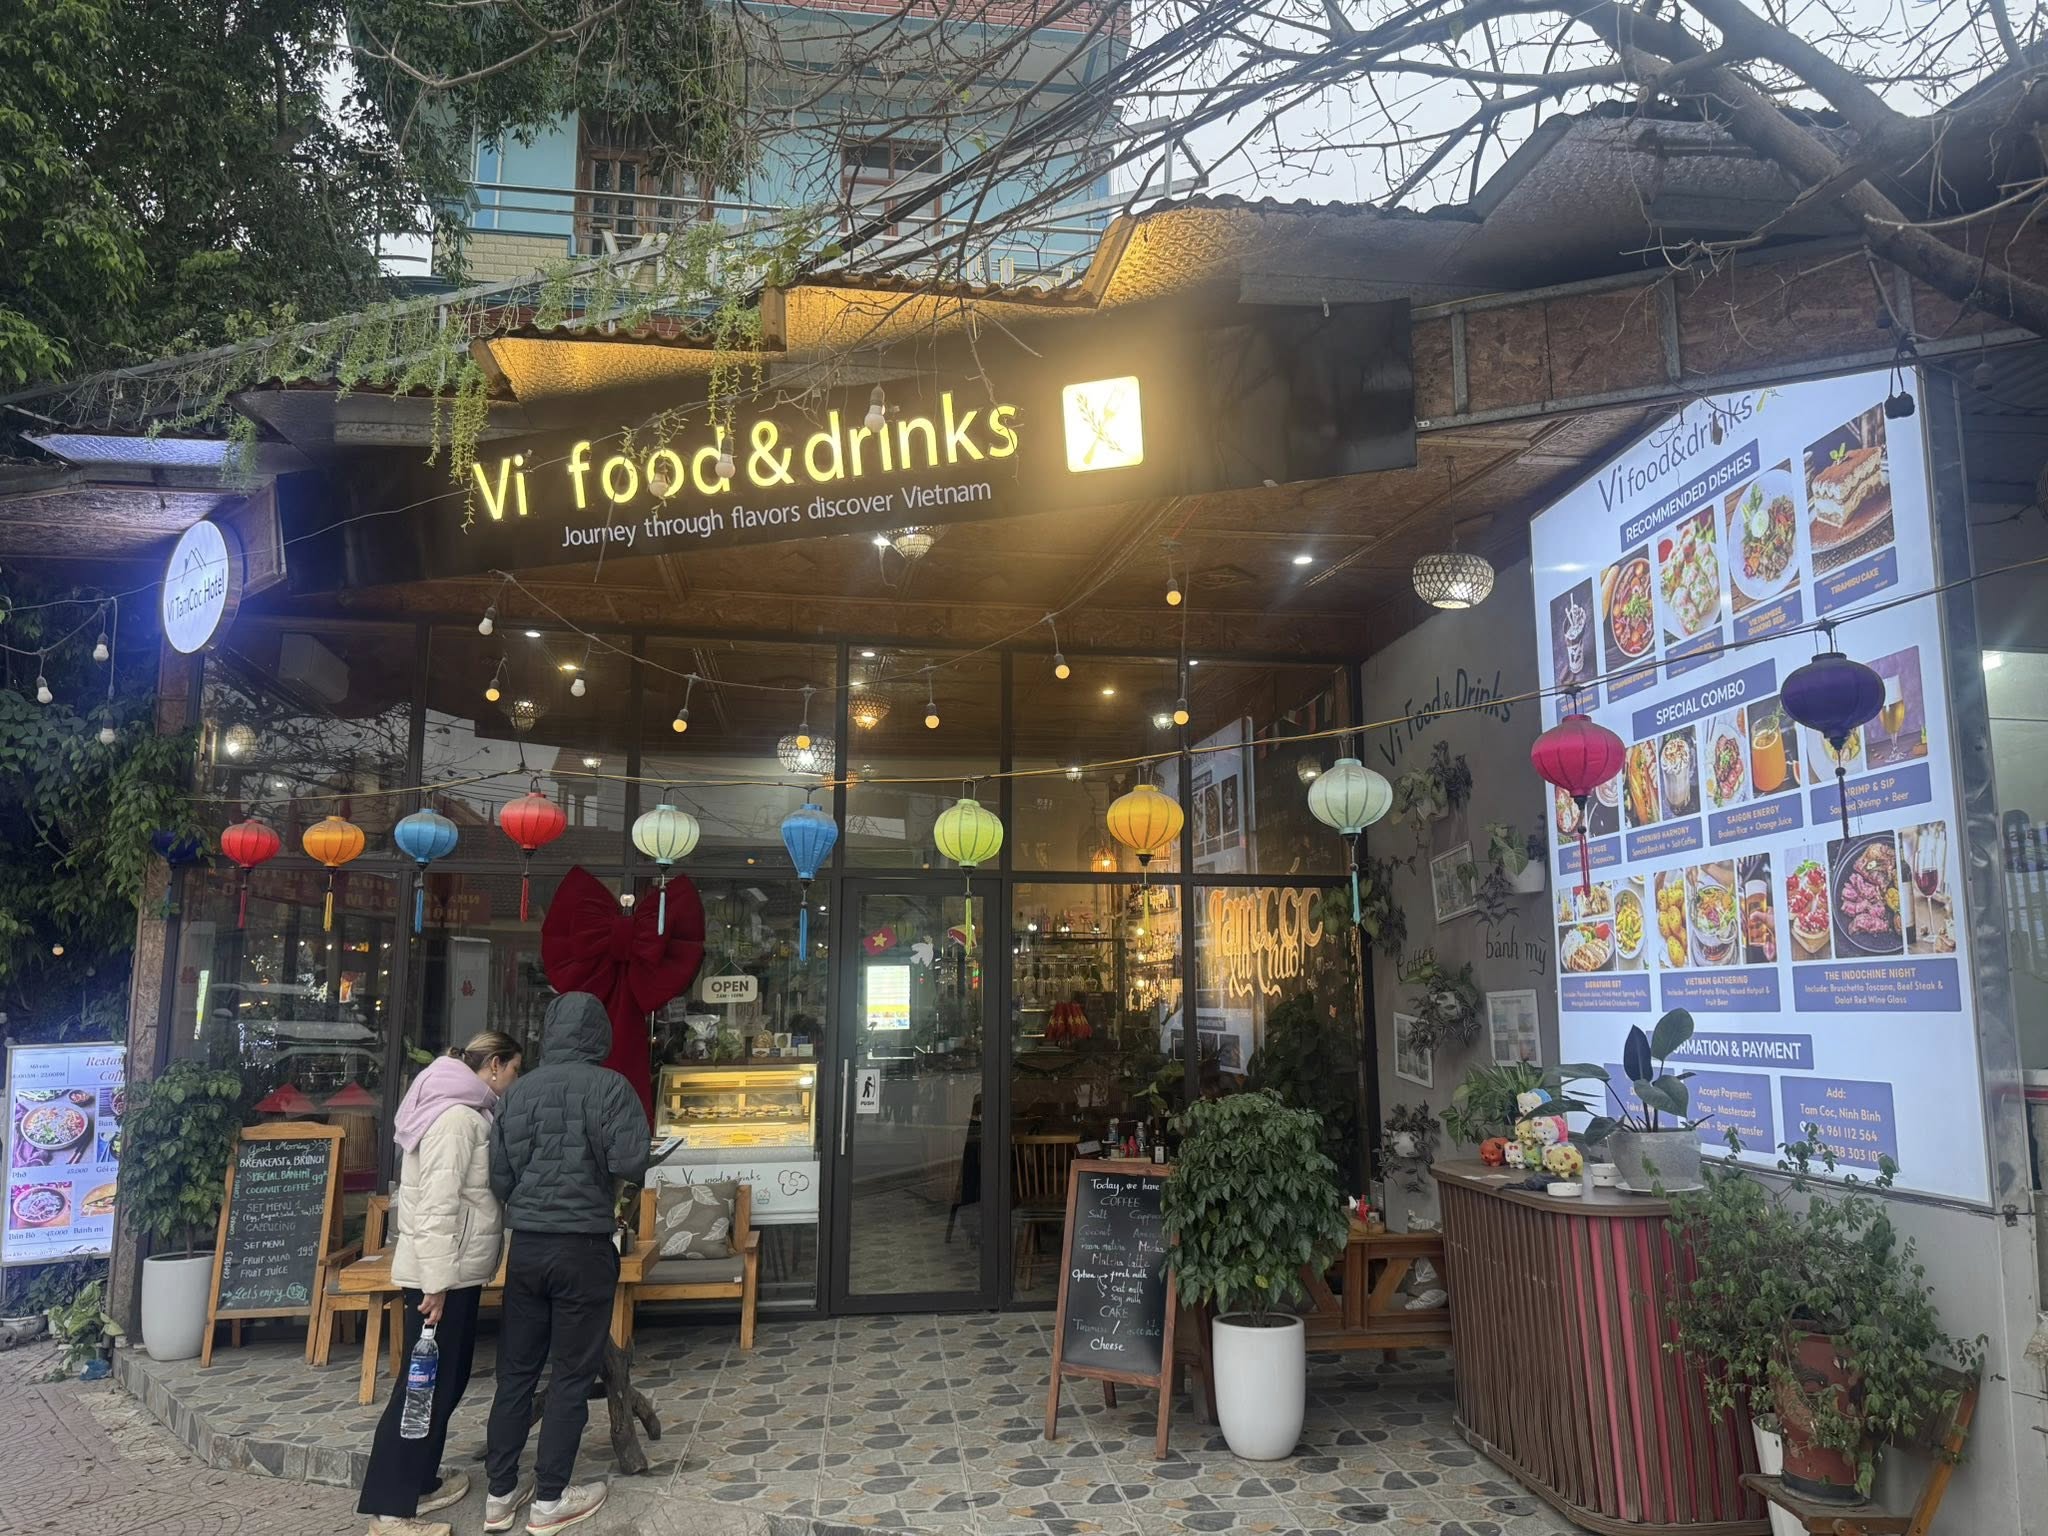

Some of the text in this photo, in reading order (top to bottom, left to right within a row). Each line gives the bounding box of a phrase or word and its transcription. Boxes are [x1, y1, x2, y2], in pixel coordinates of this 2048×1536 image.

[473, 454, 528, 520] Vi
[1598, 463, 1624, 513] Vi
[1626, 452, 1752, 543] RECOMMENDED DISHES
[562, 482, 991, 547] Journey through flavors discover Vietnam
[1861, 567, 1880, 582] CAKE
[204, 568, 225, 604] Hotel
[1656, 678, 1746, 725] SPECIAL COMBO
[1379, 727, 1403, 766] Vi
[1405, 676, 1441, 741] Food
[1455, 668, 1513, 724] Drinks
[1872, 778, 1895, 791] & SIP
[1856, 798, 1881, 810] Shrimp
[1892, 791, 1909, 801] Beer
[1727, 804, 1780, 824] SAIGON ENERGY
[1755, 821, 1776, 834] Orange
[1778, 817, 1792, 827] Juice
[1685, 975, 1748, 986] VIETNAM GATHERING
[1825, 968, 1916, 981] THE INDOCHINE NIGHT
[711, 980, 749, 993] OPEN
[1831, 984, 1864, 993] Bruschetta
[1897, 982, 1913, 991] Beef
[1915, 981, 1935, 990] Steak
[1938, 981, 1944, 989] &
[1854, 995, 1866, 1004] Red
[1868, 995, 1885, 1004] Wine
[1732, 1041, 1740, 1057] &
[1743, 1041, 1801, 1060] PAYMENT
[1698, 1086, 1752, 1100] Accept Payment:
[1826, 1088, 1846, 1099] Add:
[1696, 1101, 1711, 1112] Visa
[1718, 1105, 1756, 1118] Mastercard
[1800, 1103, 1881, 1122] Tam Coc, Ninh Binh
[1827, 1125, 1841, 1137] 961
[1844, 1128, 1857, 1139] 112
[1859, 1129, 1878, 1142] 564
[248, 1142, 310, 1159] Good Morning
[1848, 1147, 1865, 1159] 303
[246, 1183, 310, 1194] COCONUT COFFEE
[1090, 1178, 1124, 1197] Today,
[1142, 1178, 1160, 1190] have
[247, 1201, 292, 1213] SET MENU
[1100, 1197, 1140, 1207] COFFEE
[1088, 1209, 1107, 1219] Salt
[244, 1240, 285, 1250] SET MENU
[243, 1253, 290, 1265] FRUIT SALAD
[241, 1268, 262, 1278] FRUIT
[1110, 1268, 1147, 1283] fresh milk
[1111, 1281, 1125, 1293] oat
[1100, 1305, 1128, 1318] CAKE
[1090, 1337, 1126, 1351] Cheese
